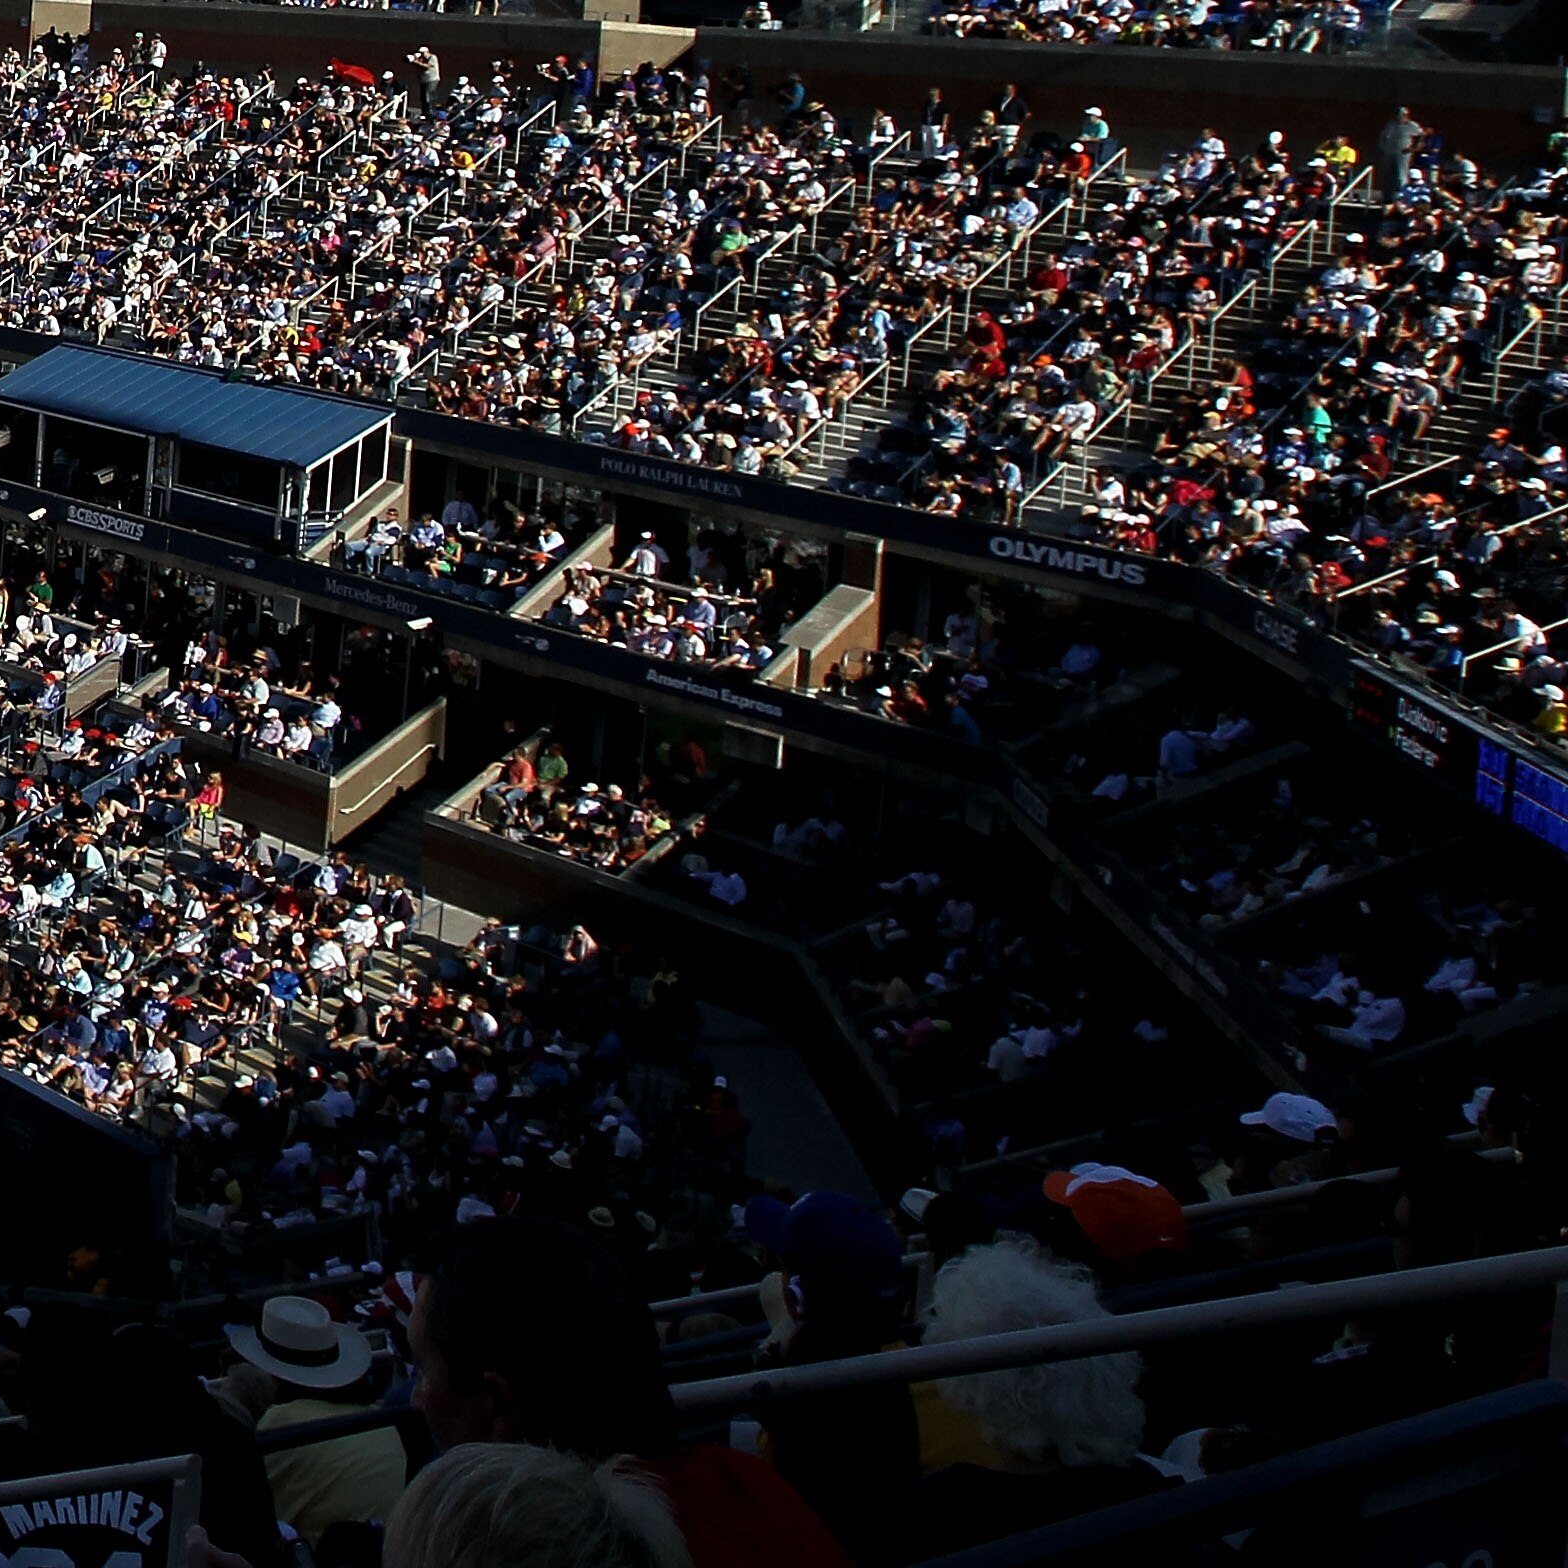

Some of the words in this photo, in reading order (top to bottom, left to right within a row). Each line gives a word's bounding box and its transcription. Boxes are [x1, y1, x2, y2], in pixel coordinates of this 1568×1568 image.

[599, 456, 638, 474] POLO
[639, 461, 684, 486] RALPH
[686, 472, 745, 499] LAUREN
[989, 536, 1148, 585] OLYMPUS
[324, 576, 420, 616] Mercedes-Benz
[645, 668, 720, 701] American
[720, 687, 784, 718] Express
